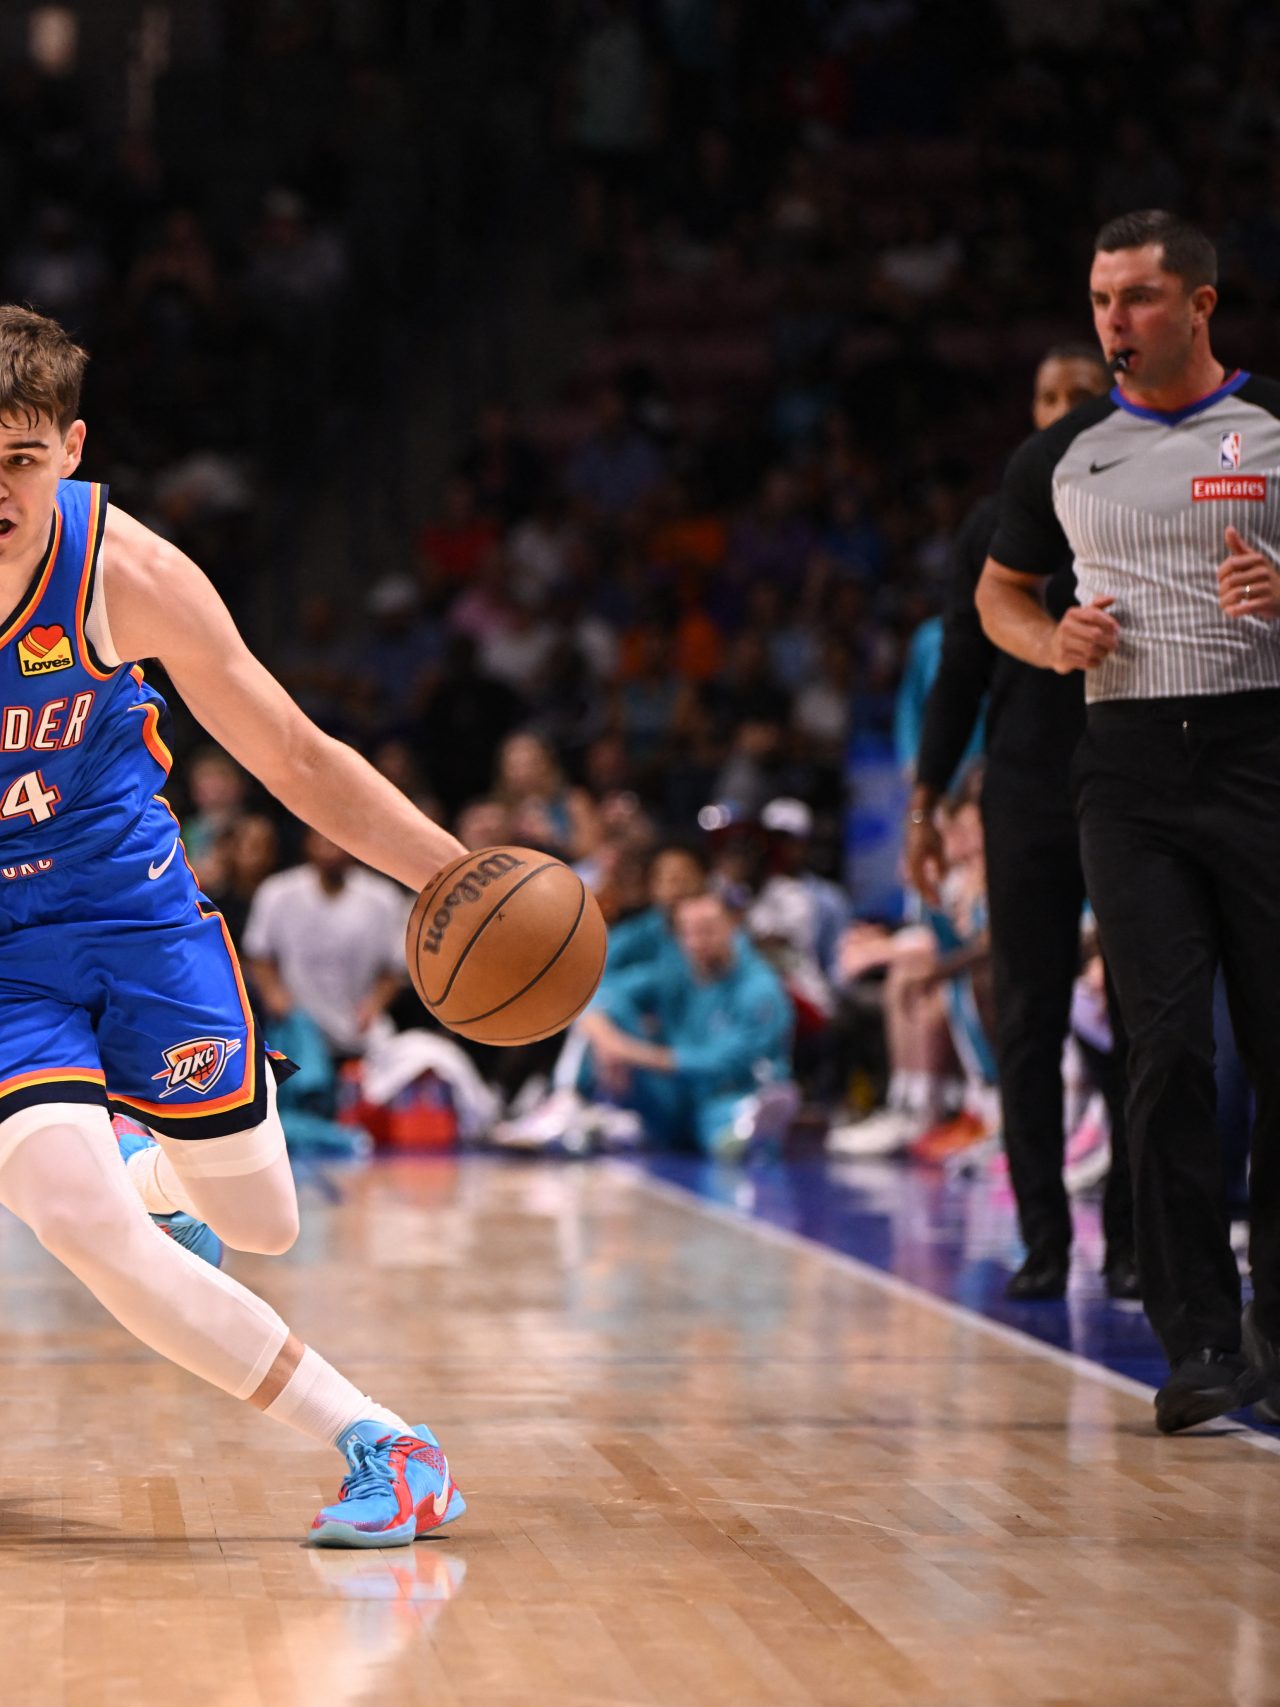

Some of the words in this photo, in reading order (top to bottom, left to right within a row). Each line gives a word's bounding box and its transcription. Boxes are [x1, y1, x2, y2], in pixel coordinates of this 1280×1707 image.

[1193, 478, 1264, 497] Emirates
[423, 853, 526, 955] Wilson
[168, 1045, 215, 1088] OKC
